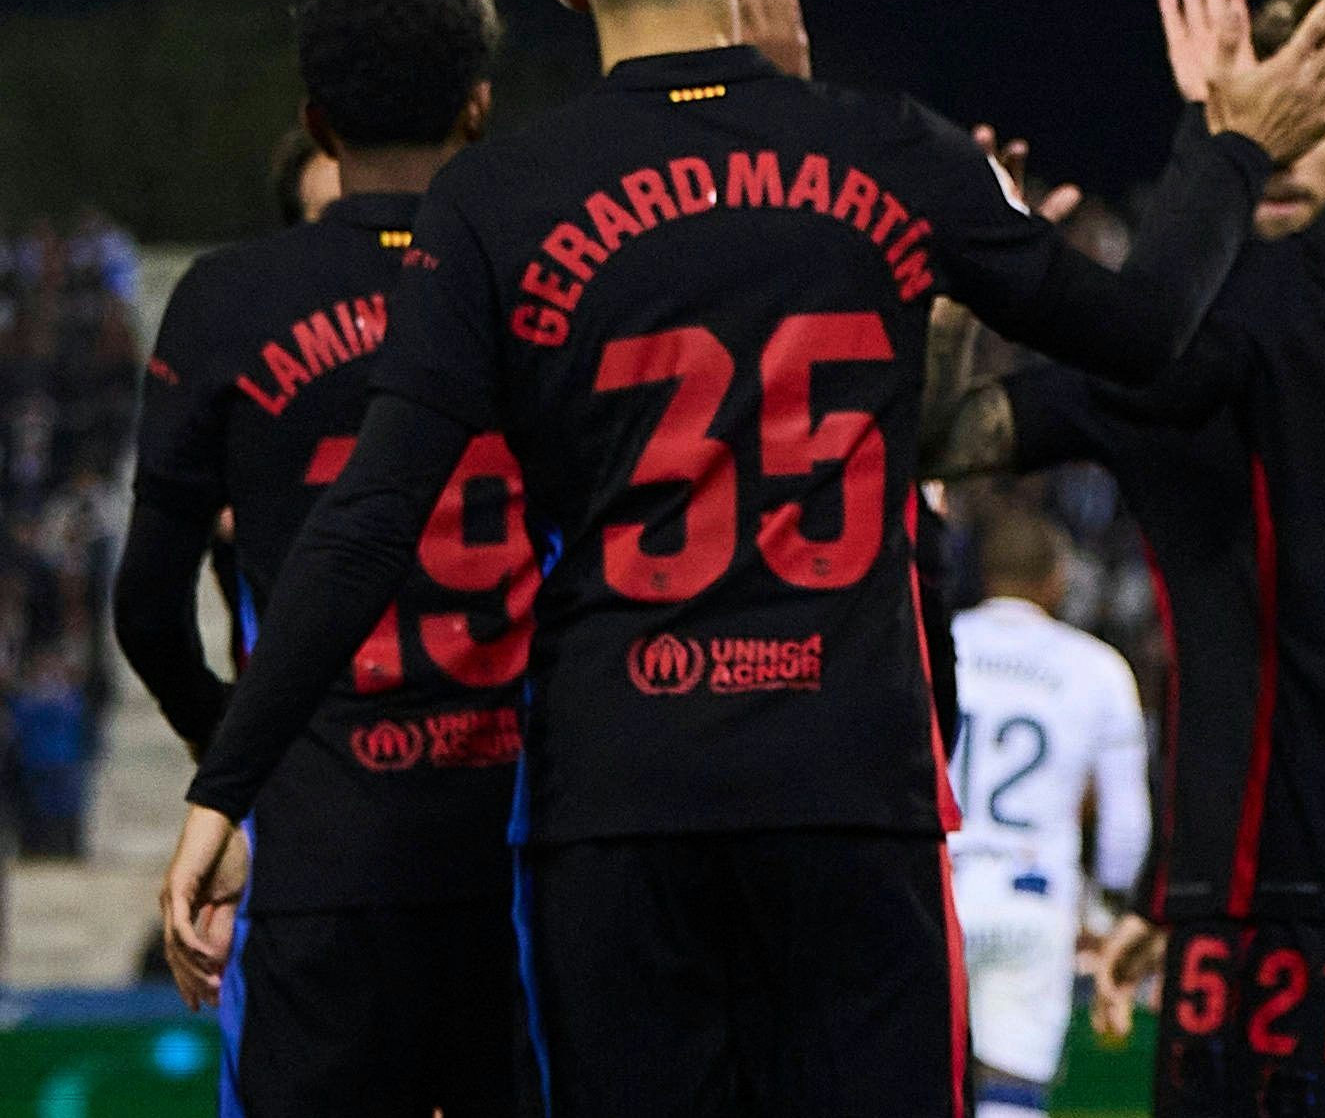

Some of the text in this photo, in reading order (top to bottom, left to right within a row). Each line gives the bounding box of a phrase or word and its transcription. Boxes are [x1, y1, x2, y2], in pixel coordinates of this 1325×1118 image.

[511, 155, 717, 347] GERARD
[236, 293, 388, 416] LAMIN
[594, 312, 896, 603] 35
[1176, 935, 1230, 1035] 5
